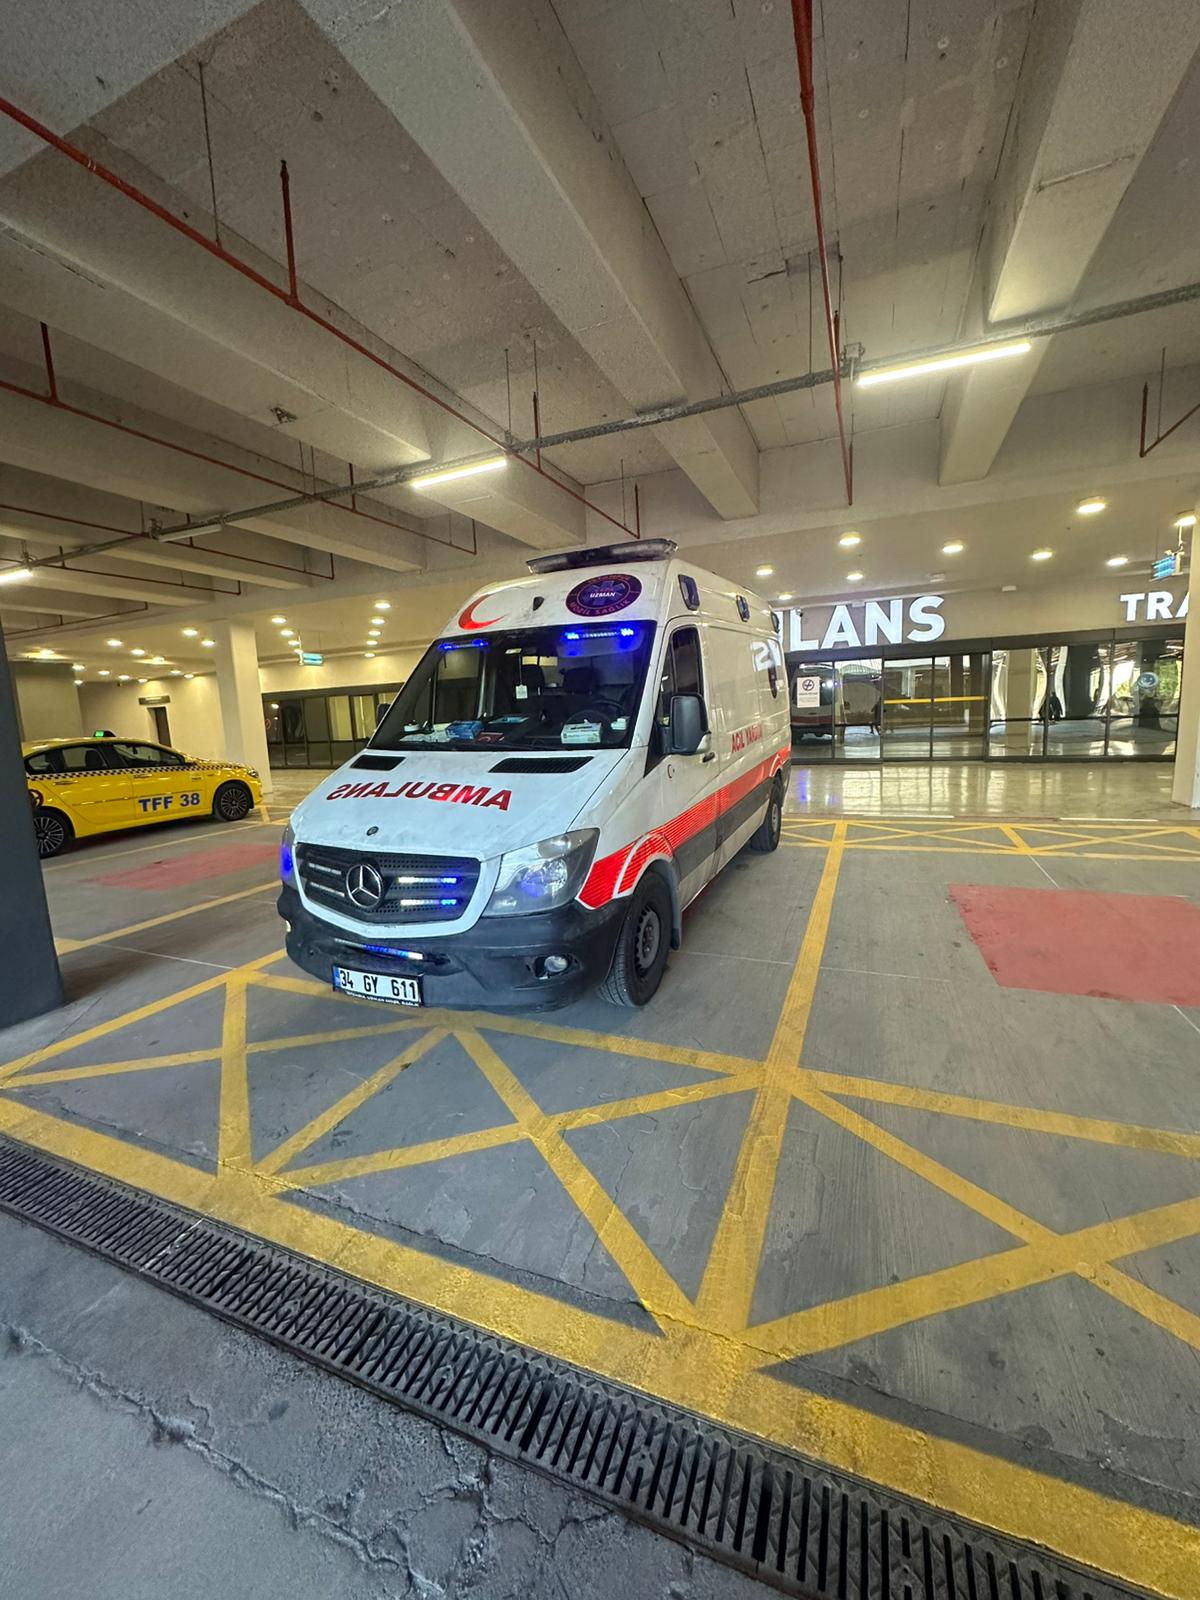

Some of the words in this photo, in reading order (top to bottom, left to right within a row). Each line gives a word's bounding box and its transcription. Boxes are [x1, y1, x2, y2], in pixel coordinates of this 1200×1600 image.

[589, 591, 616, 599] UZMAN
[138, 796, 174, 812] TFF
[179, 792, 201, 808] 38
[339, 969, 354, 989] 34
[363, 974, 378, 994] GY
[390, 979, 416, 1000] 611
